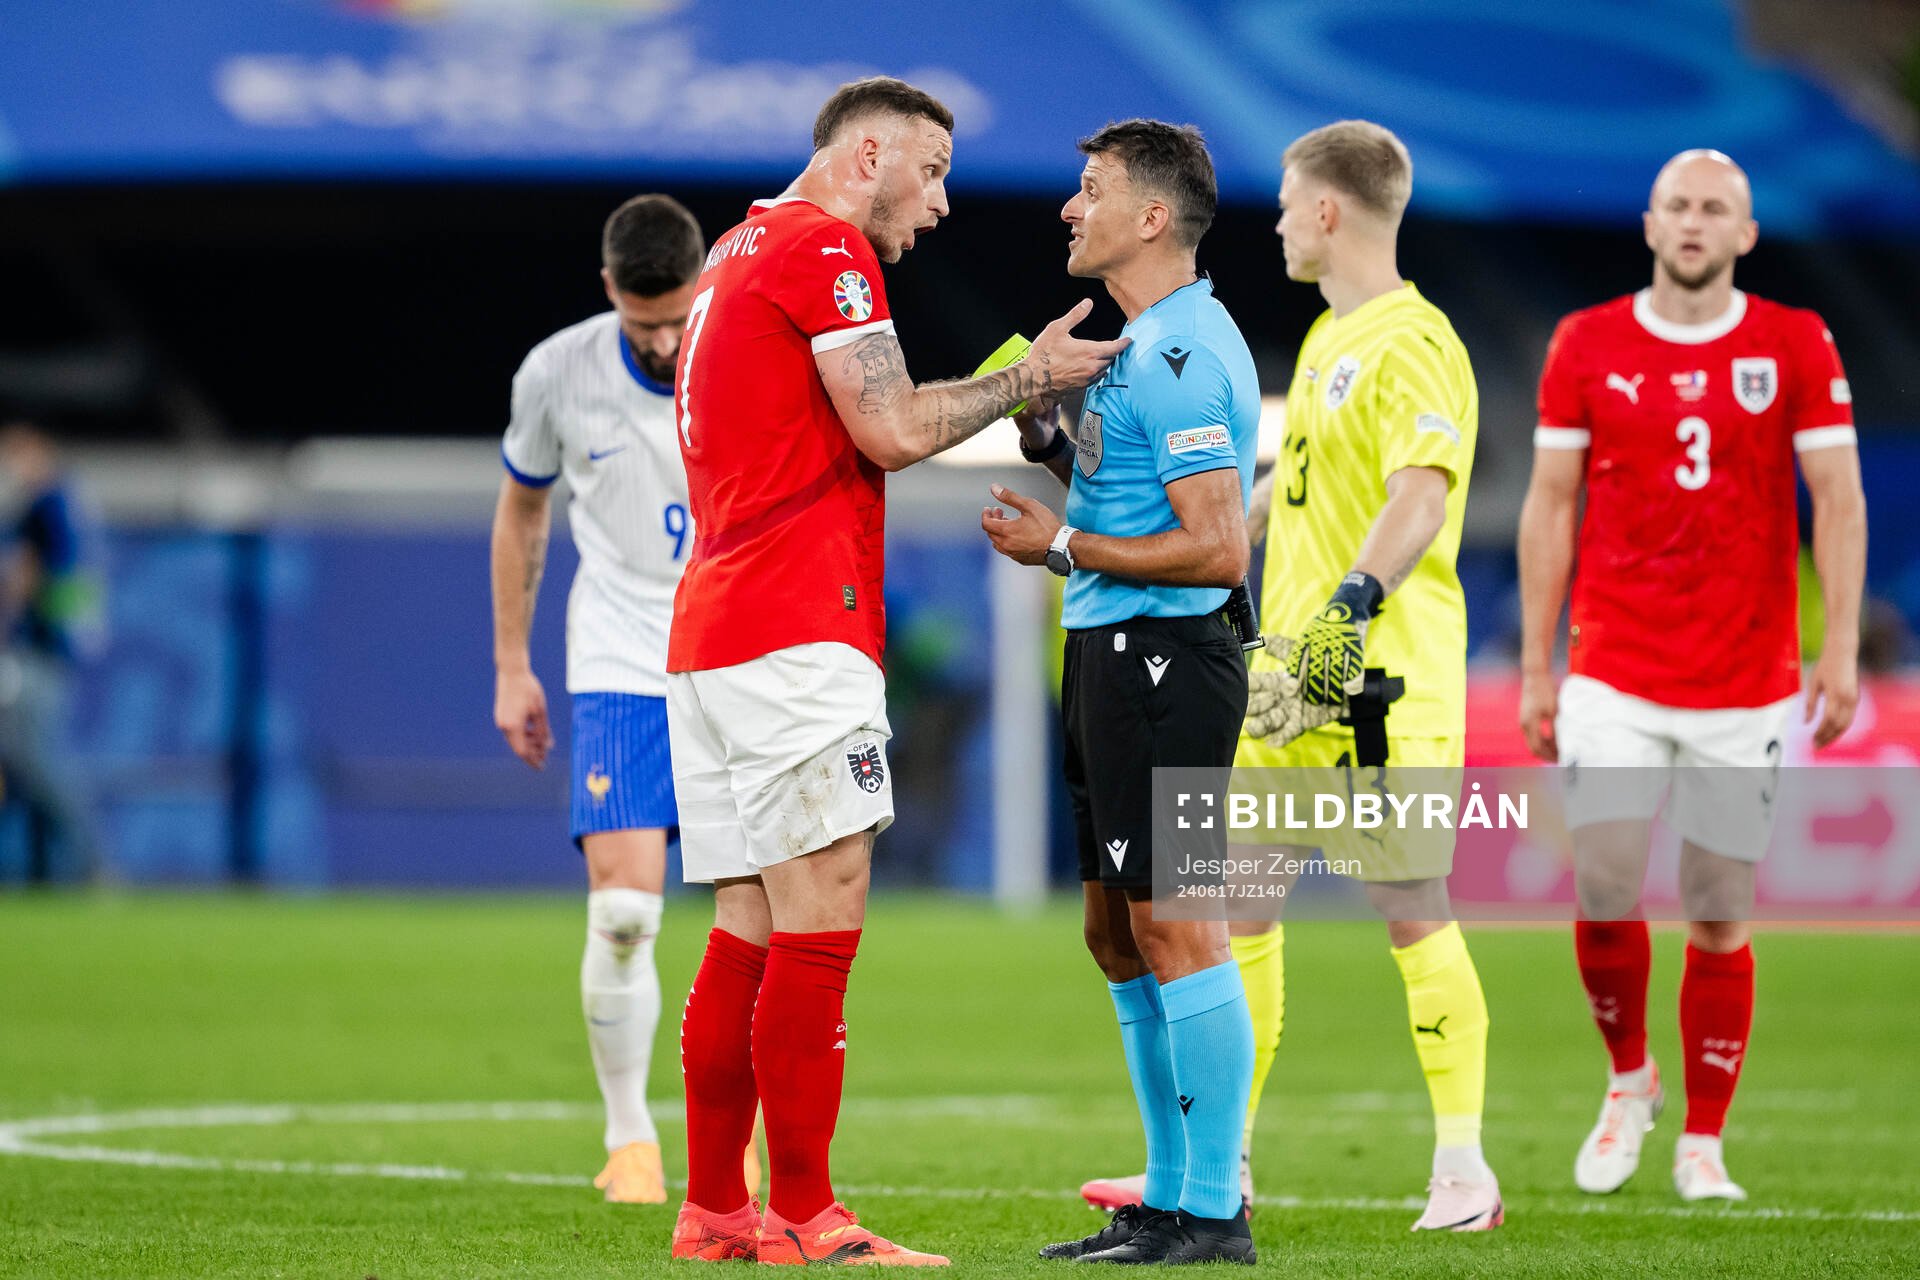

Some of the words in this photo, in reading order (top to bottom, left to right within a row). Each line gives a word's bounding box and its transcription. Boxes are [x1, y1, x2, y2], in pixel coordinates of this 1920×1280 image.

[681, 285, 715, 447] 7
[1169, 432, 1227, 448] FOUNDATION
[1674, 416, 1711, 490] 3
[664, 503, 687, 560] 9
